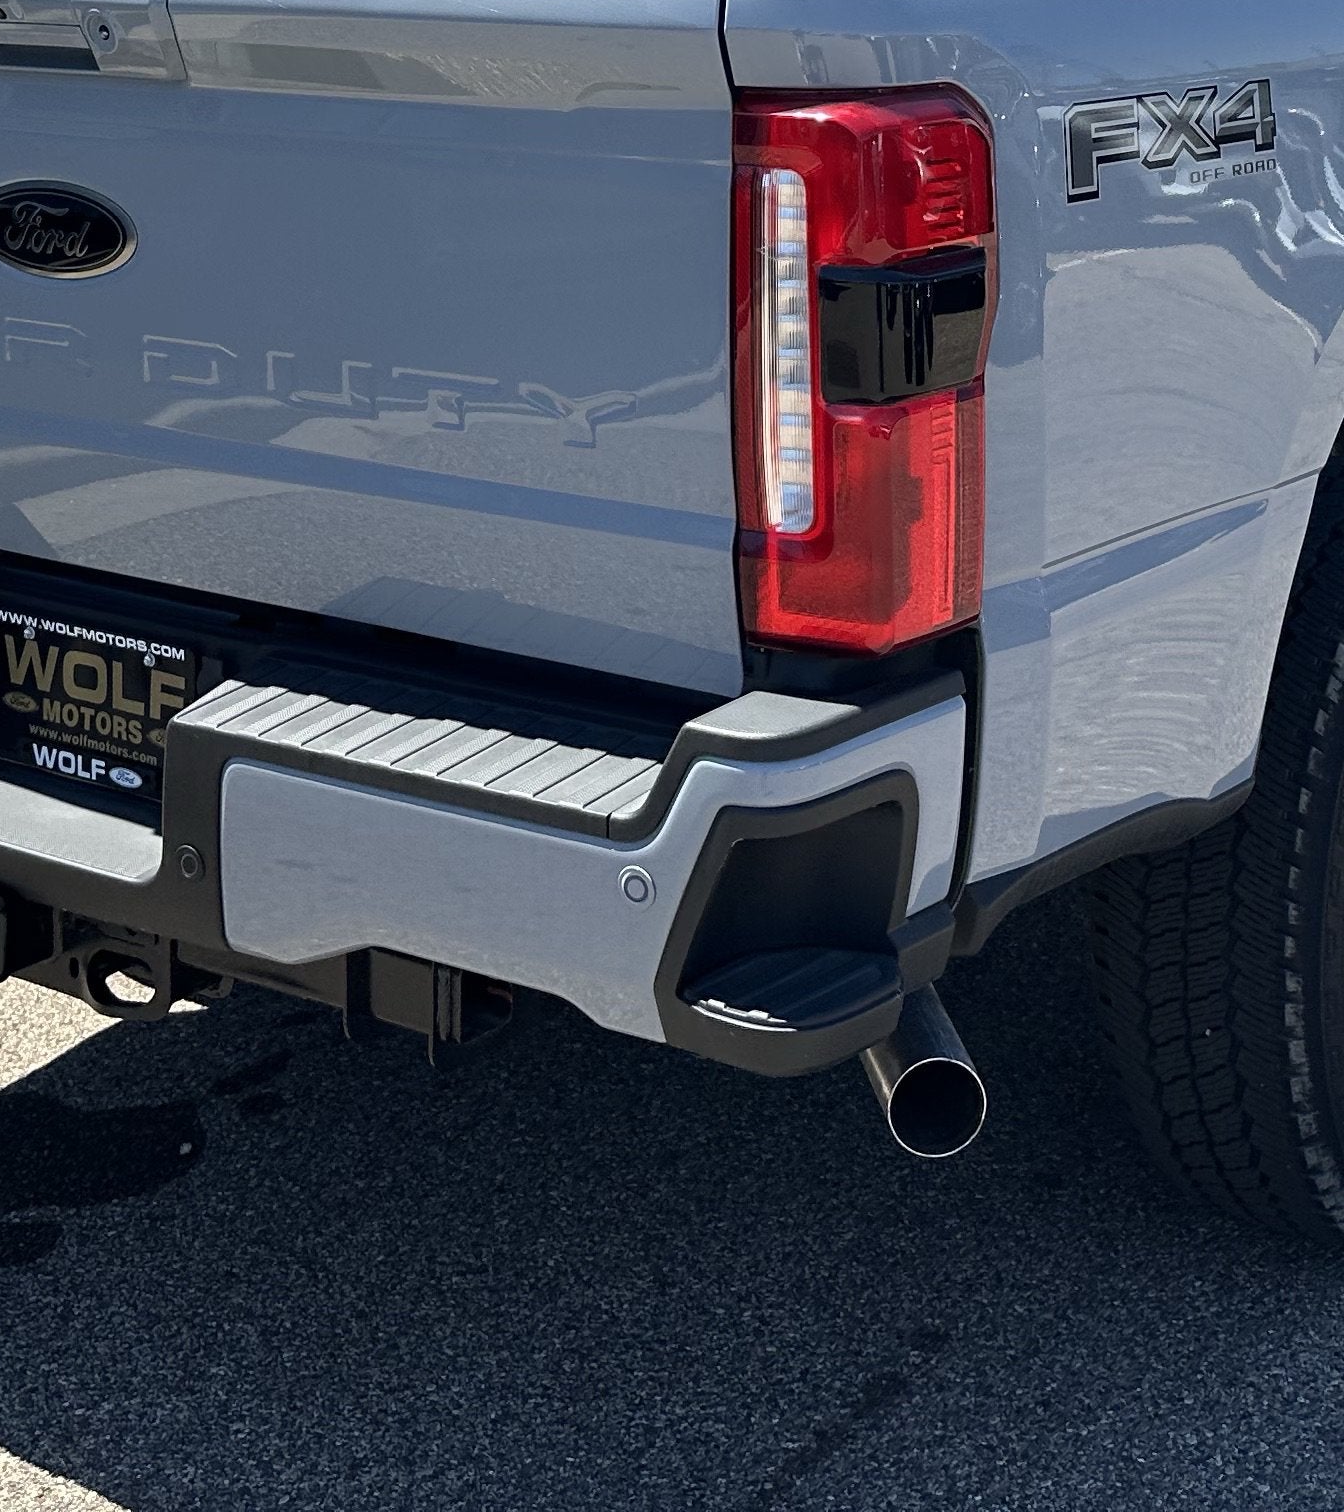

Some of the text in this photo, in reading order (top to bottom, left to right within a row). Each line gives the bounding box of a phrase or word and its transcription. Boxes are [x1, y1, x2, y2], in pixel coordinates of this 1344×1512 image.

[1063, 78, 1277, 205] FX4
[1189, 157, 1278, 185] OFF ROAD
[4, 200, 92, 258] Ford
[143, 334, 638, 449] DUTY
[4, 633, 187, 721] WOLF
[28, 723, 158, 767] www.wolfmotors.com
[42, 696, 144, 745] MOTORS
[32, 742, 107, 781] WOLF
